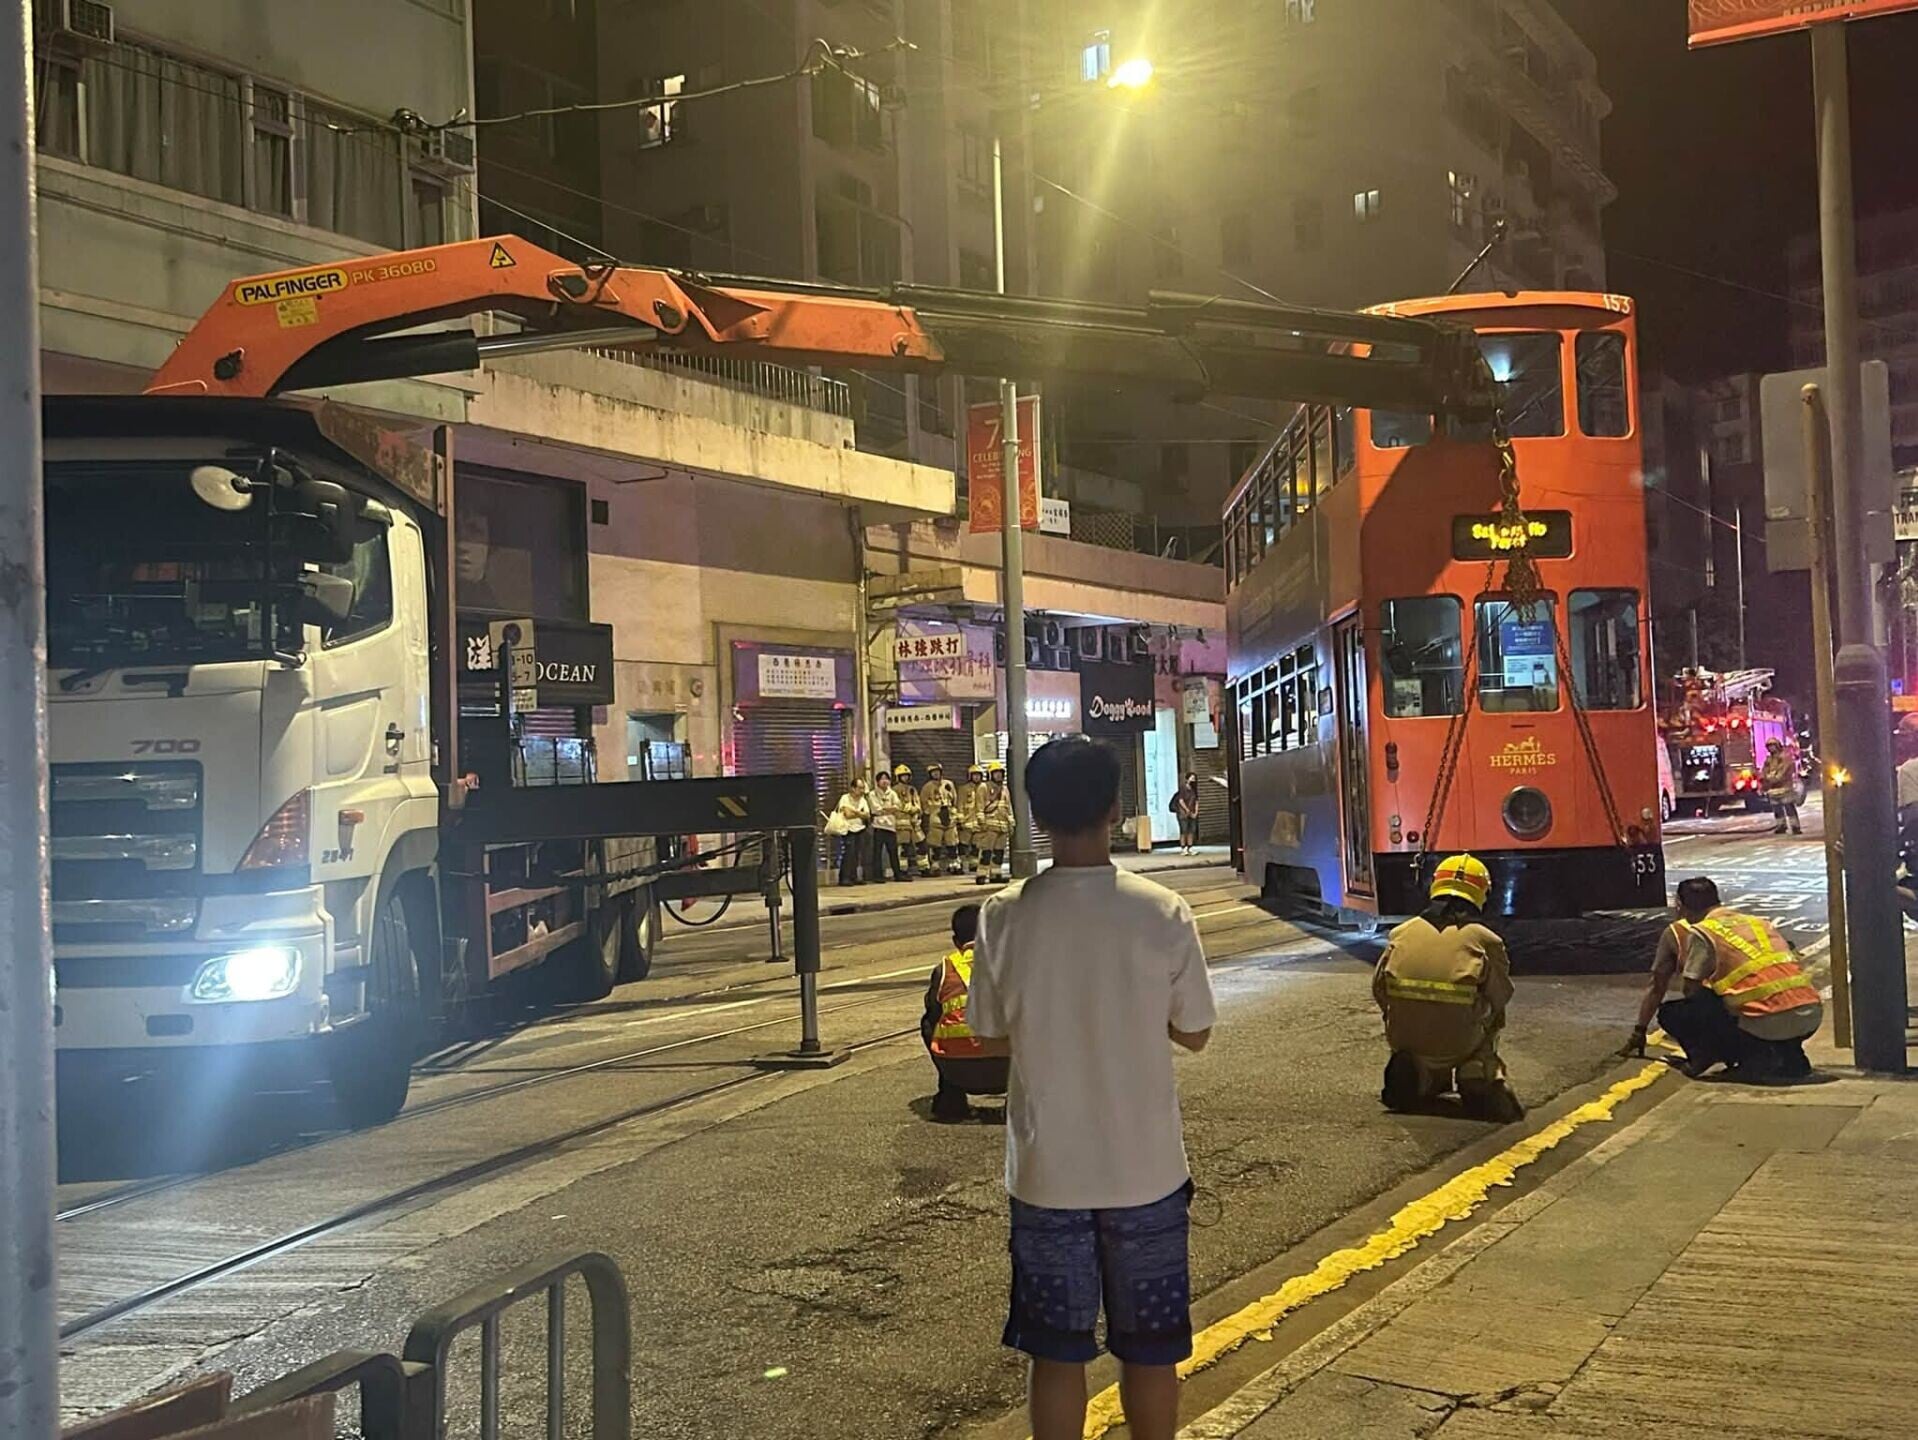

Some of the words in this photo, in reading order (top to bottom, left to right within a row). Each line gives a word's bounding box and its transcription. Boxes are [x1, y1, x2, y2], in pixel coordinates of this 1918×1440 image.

[242, 273, 342, 302] PALFINGER
[352, 270, 375, 285] PK
[378, 258, 437, 281] 36080
[1603, 294, 1631, 314] 153
[130, 738, 201, 755] 700
